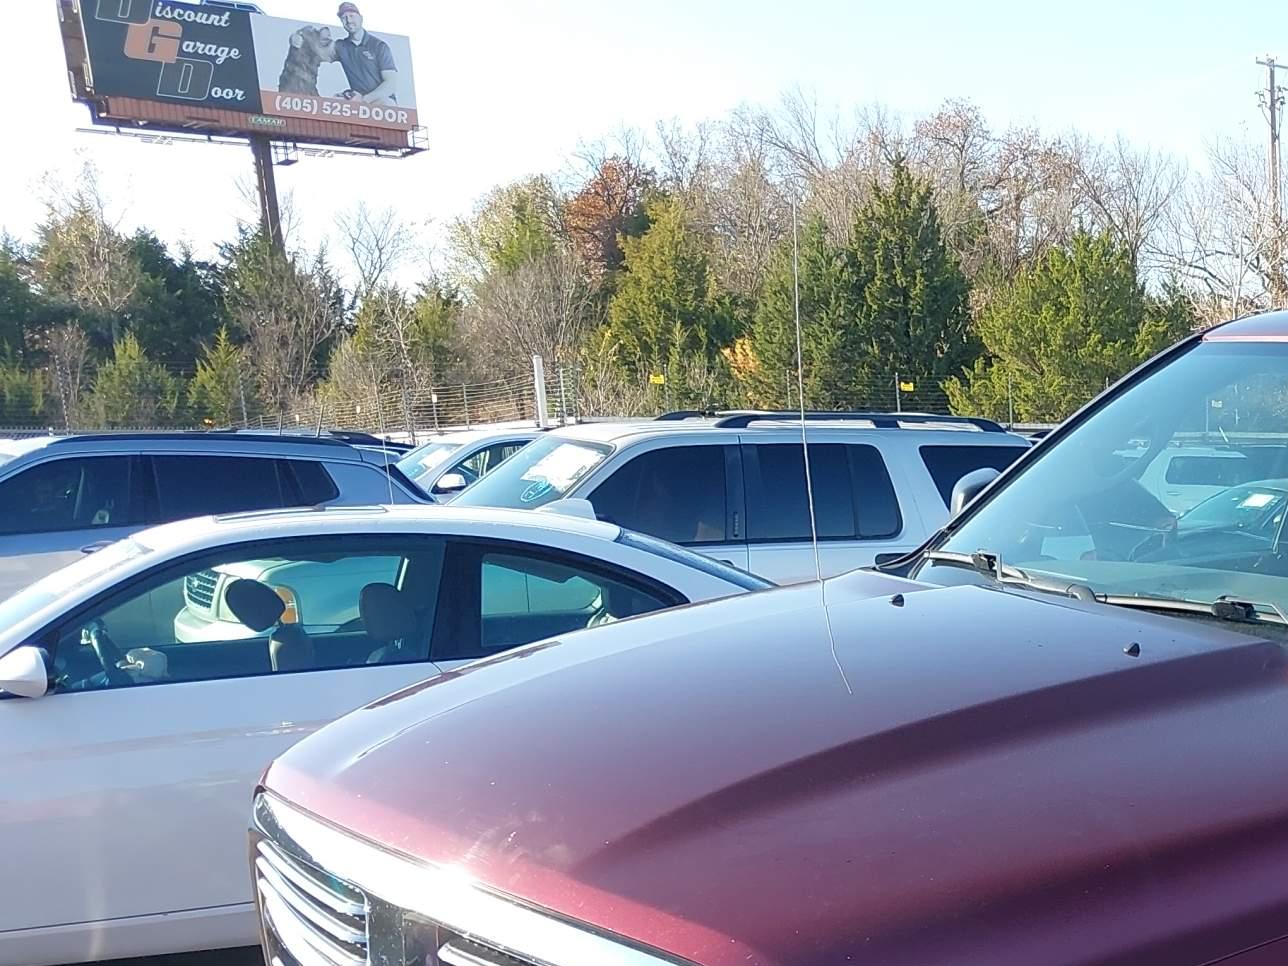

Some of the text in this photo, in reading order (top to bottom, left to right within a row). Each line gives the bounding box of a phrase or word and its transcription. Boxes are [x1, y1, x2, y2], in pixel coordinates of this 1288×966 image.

[124, 18, 242, 64] Garage
[156, 57, 246, 101] Door
[275, 95, 408, 124] (405) 525-DOOR
